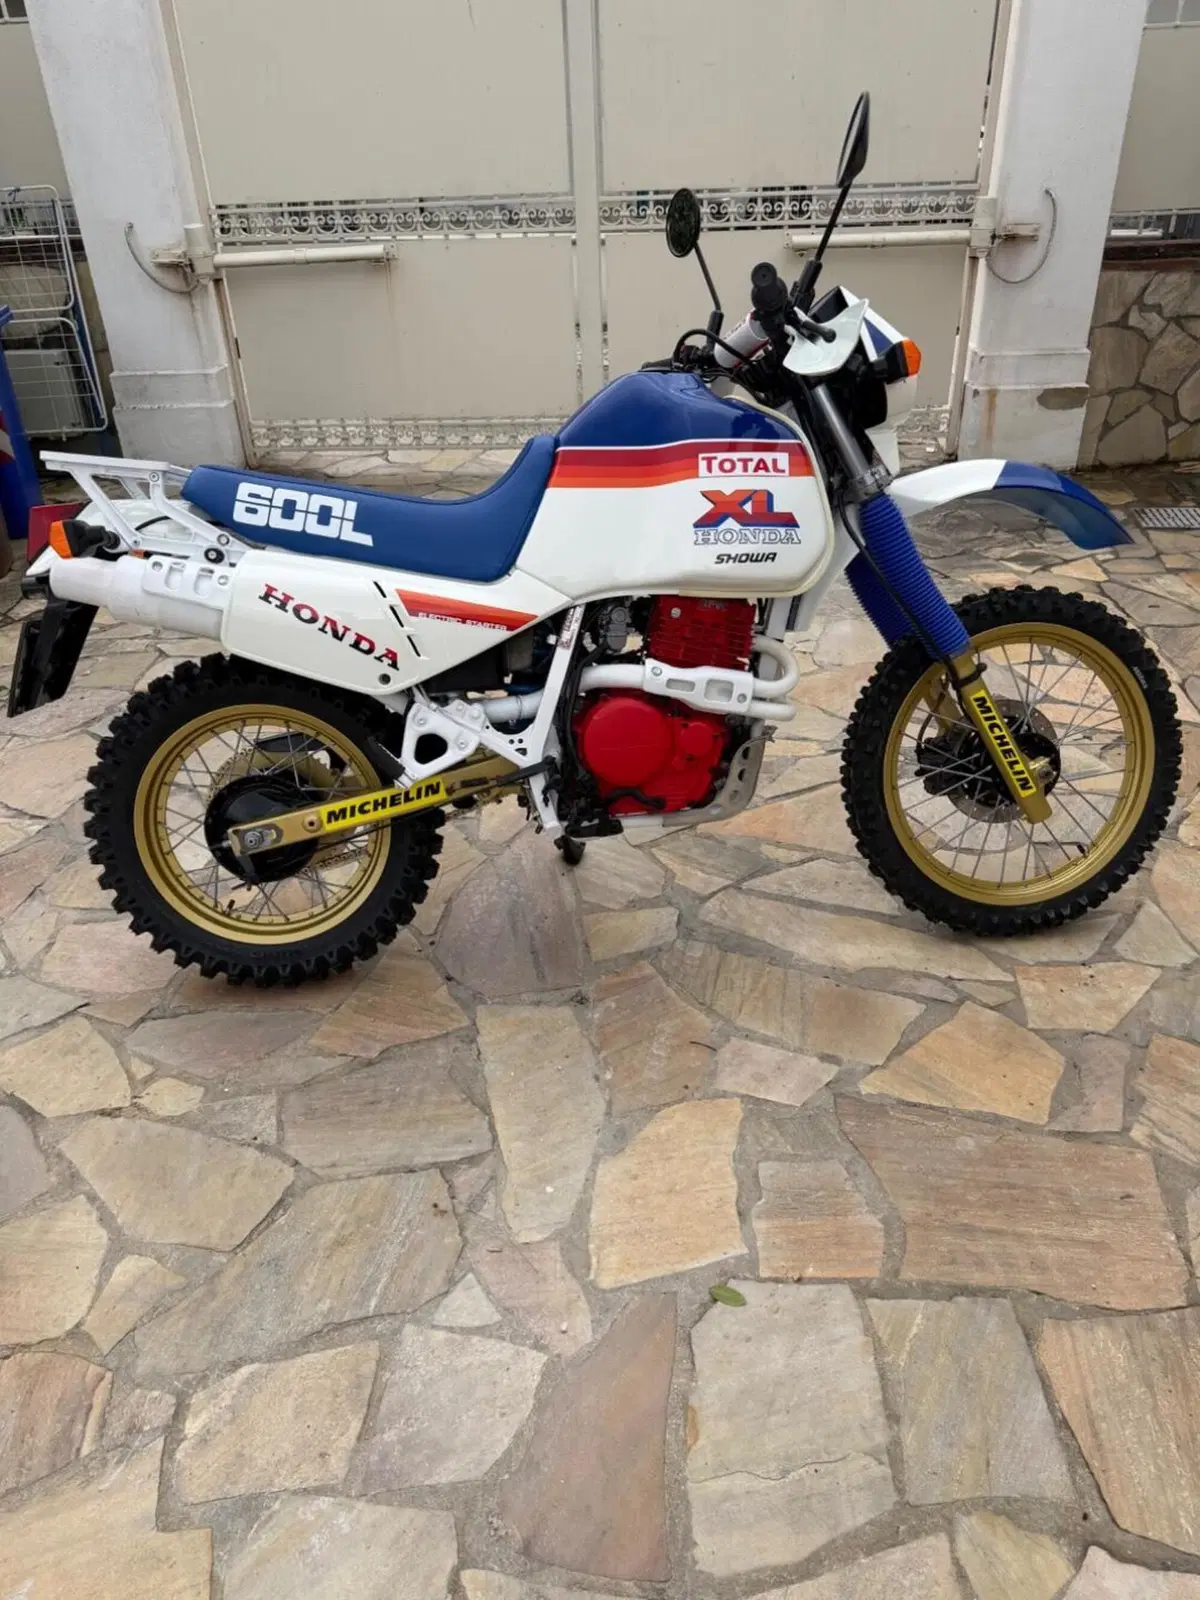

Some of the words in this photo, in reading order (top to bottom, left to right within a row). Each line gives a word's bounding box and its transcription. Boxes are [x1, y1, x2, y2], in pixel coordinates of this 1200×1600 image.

[701, 456, 786, 474] TOTAL
[232, 482, 374, 547] 600L
[692, 488, 800, 529] XL
[693, 528, 802, 546] HONDA
[714, 552, 778, 565] SHOWA
[258, 583, 400, 671] HONDA
[418, 612, 463, 624] ELECTRIC
[465, 619, 508, 631] STARTER
[972, 696, 1034, 792] MICHELIN
[326, 781, 442, 824] MICHELIN
